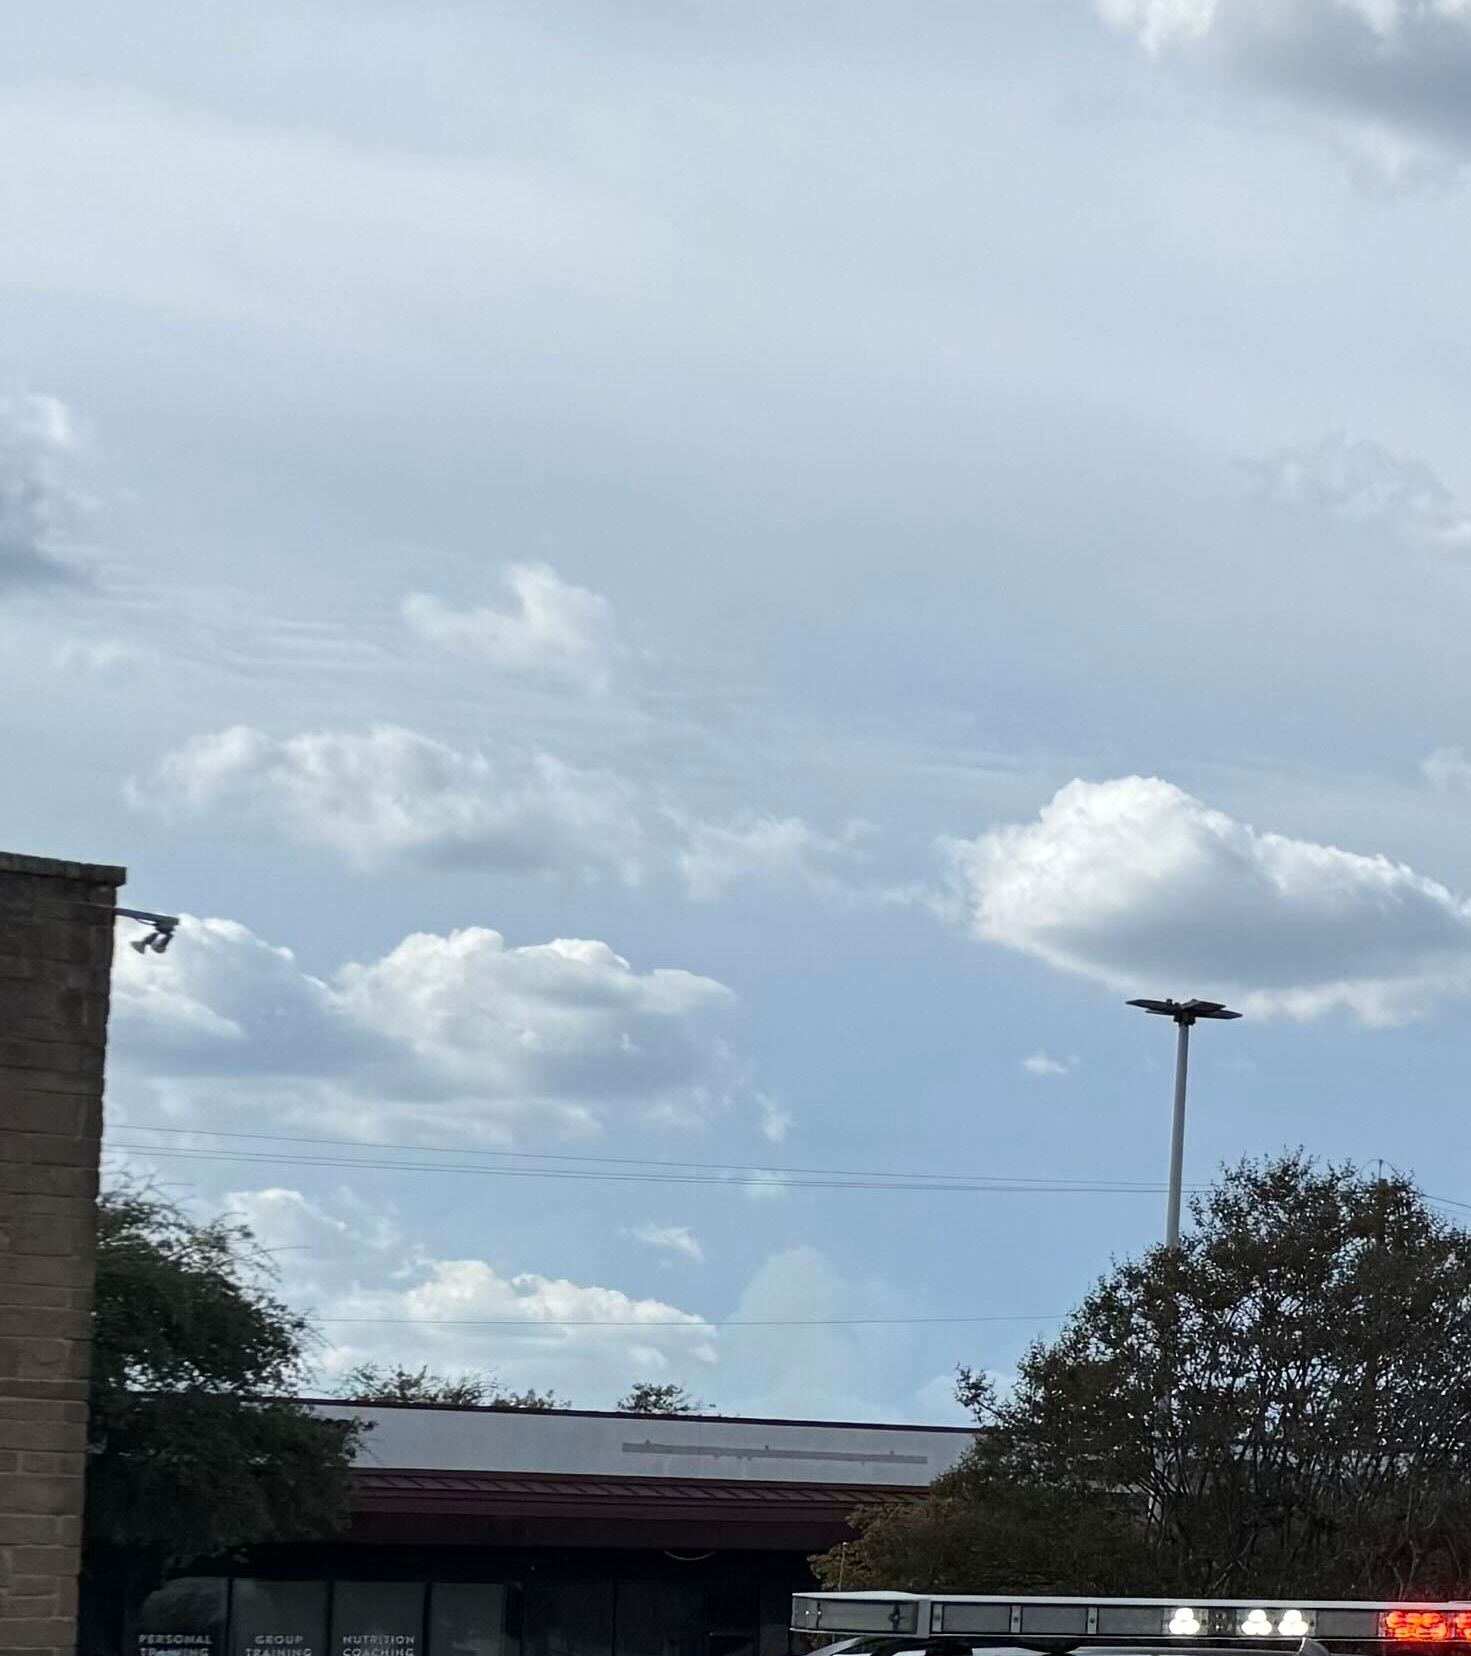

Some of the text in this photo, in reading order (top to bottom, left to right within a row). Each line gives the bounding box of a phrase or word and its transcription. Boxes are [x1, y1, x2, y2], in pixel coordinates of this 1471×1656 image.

[138, 1633, 213, 1645] PERSONAL
[254, 1635, 304, 1645] GROUP
[342, 1635, 416, 1645] NUTRITION
